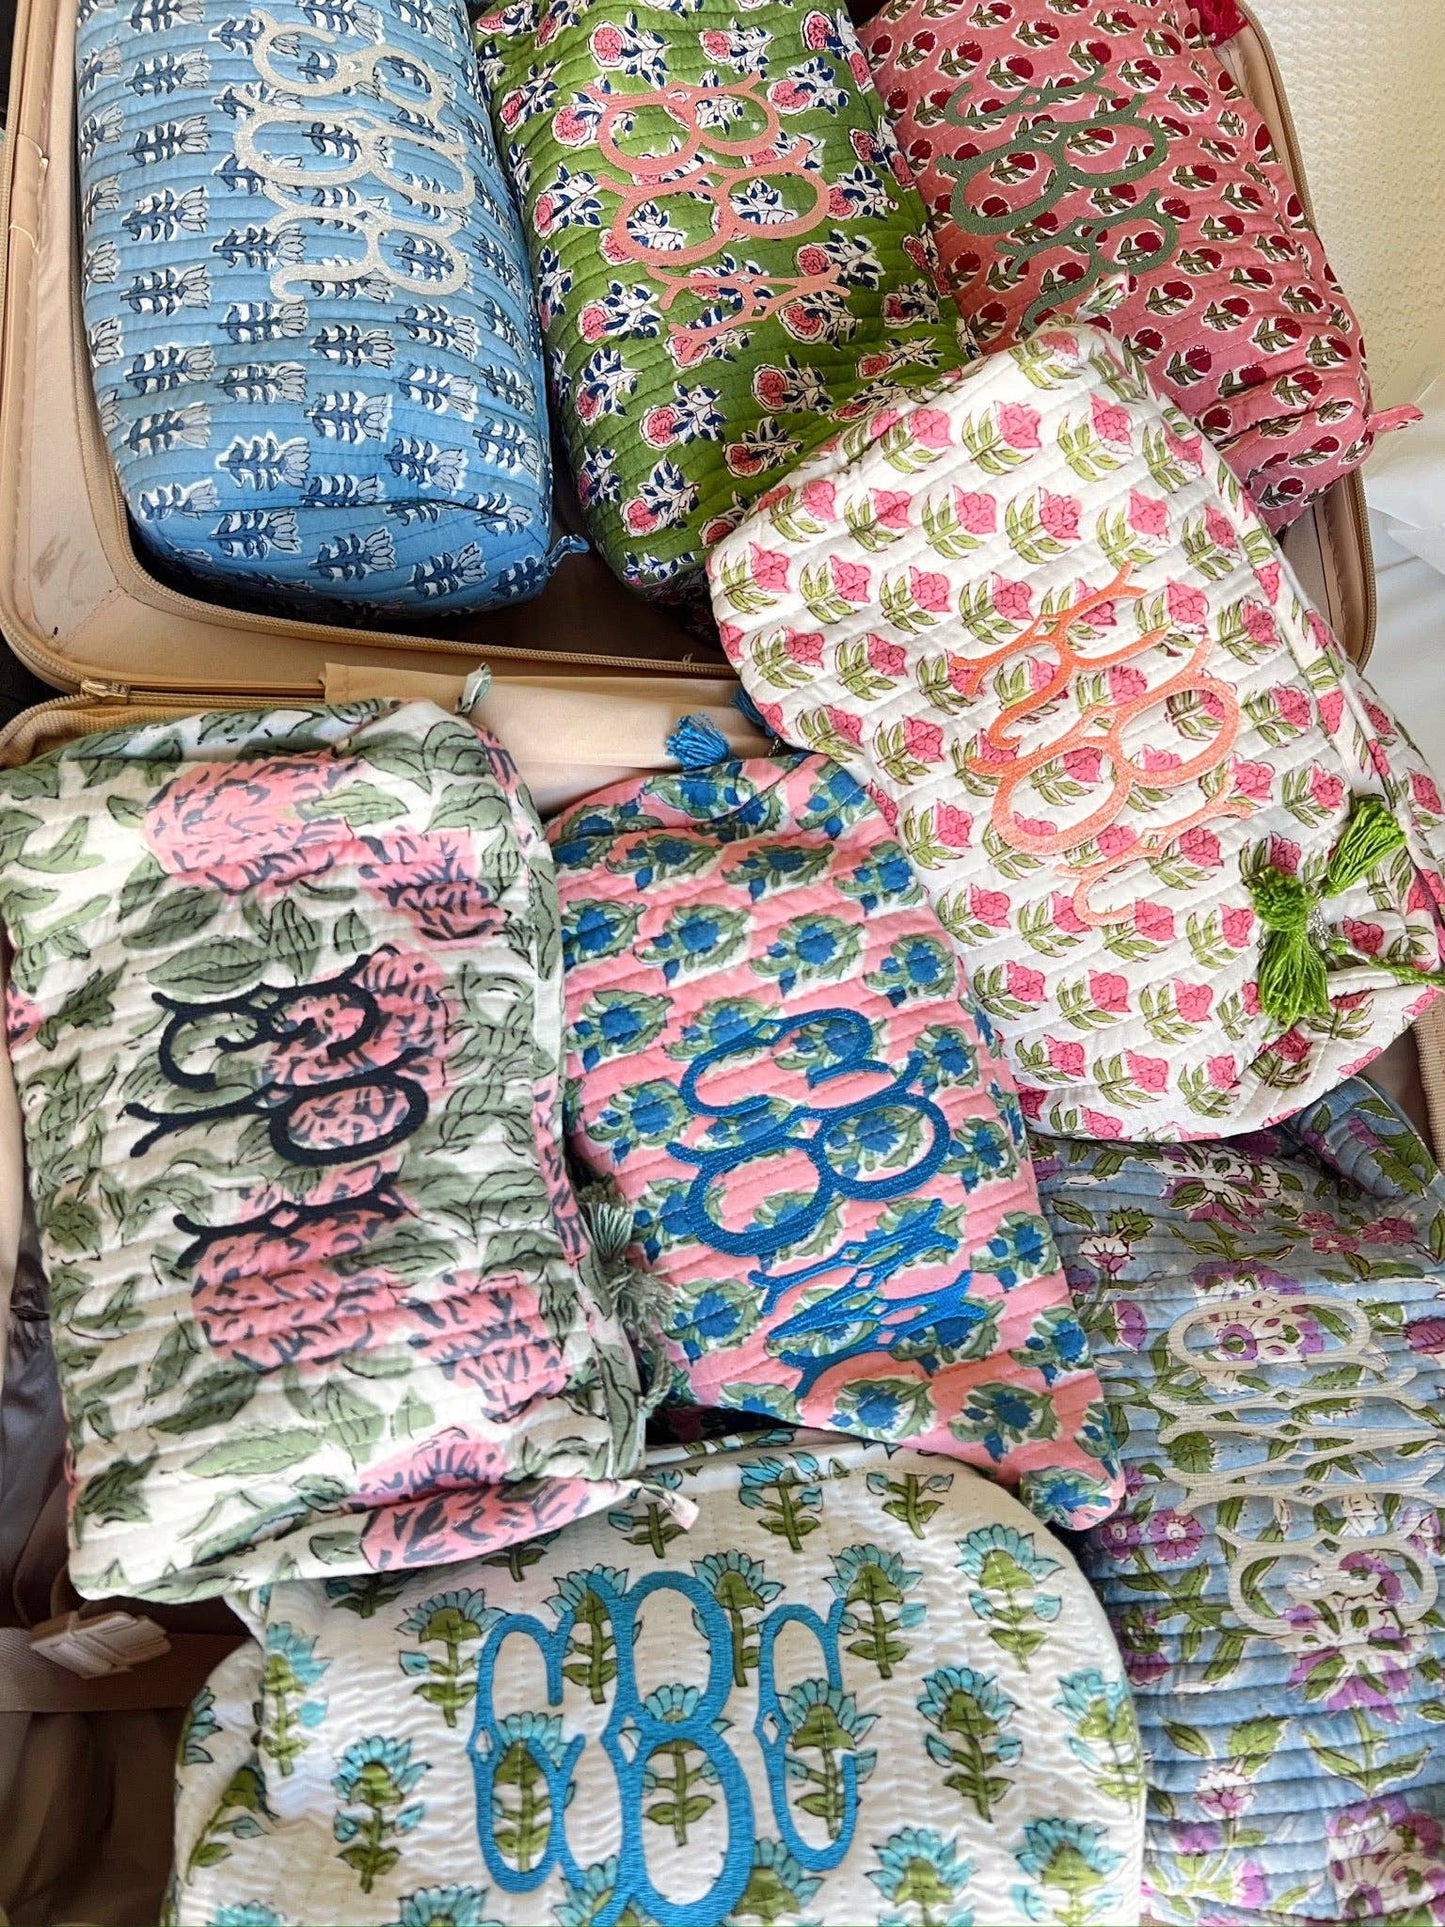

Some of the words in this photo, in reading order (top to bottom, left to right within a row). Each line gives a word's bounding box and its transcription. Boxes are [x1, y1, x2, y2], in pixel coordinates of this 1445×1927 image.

[583, 71, 851, 364] BBA
[666, 1008, 988, 1400] CBM
[466, 1571, 858, 1927] GBC
